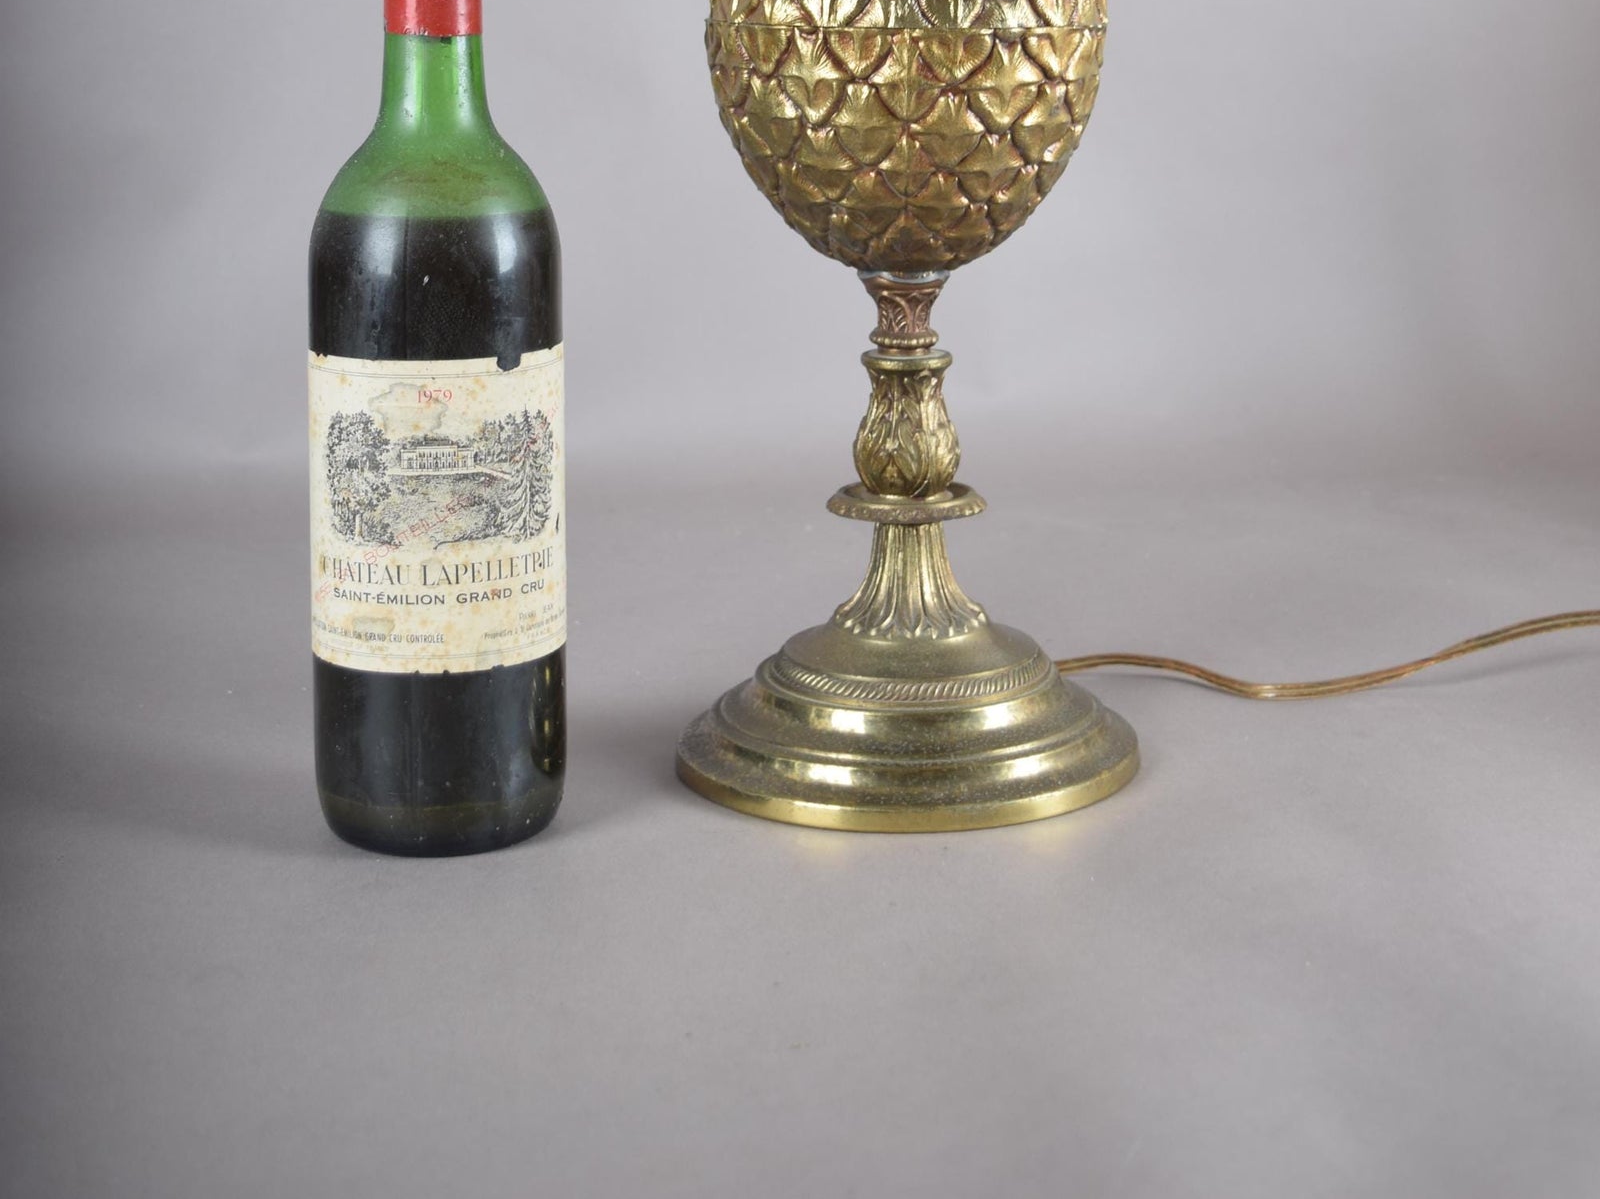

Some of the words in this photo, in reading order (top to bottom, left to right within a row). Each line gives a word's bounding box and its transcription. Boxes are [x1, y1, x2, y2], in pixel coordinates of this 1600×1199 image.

[418, 389, 453, 403] 1979
[333, 587, 445, 605] SAINT-ÉMILION
[456, 587, 513, 604] GRAND
[520, 579, 545, 595] CRU
[389, 633, 402, 643] CRU
